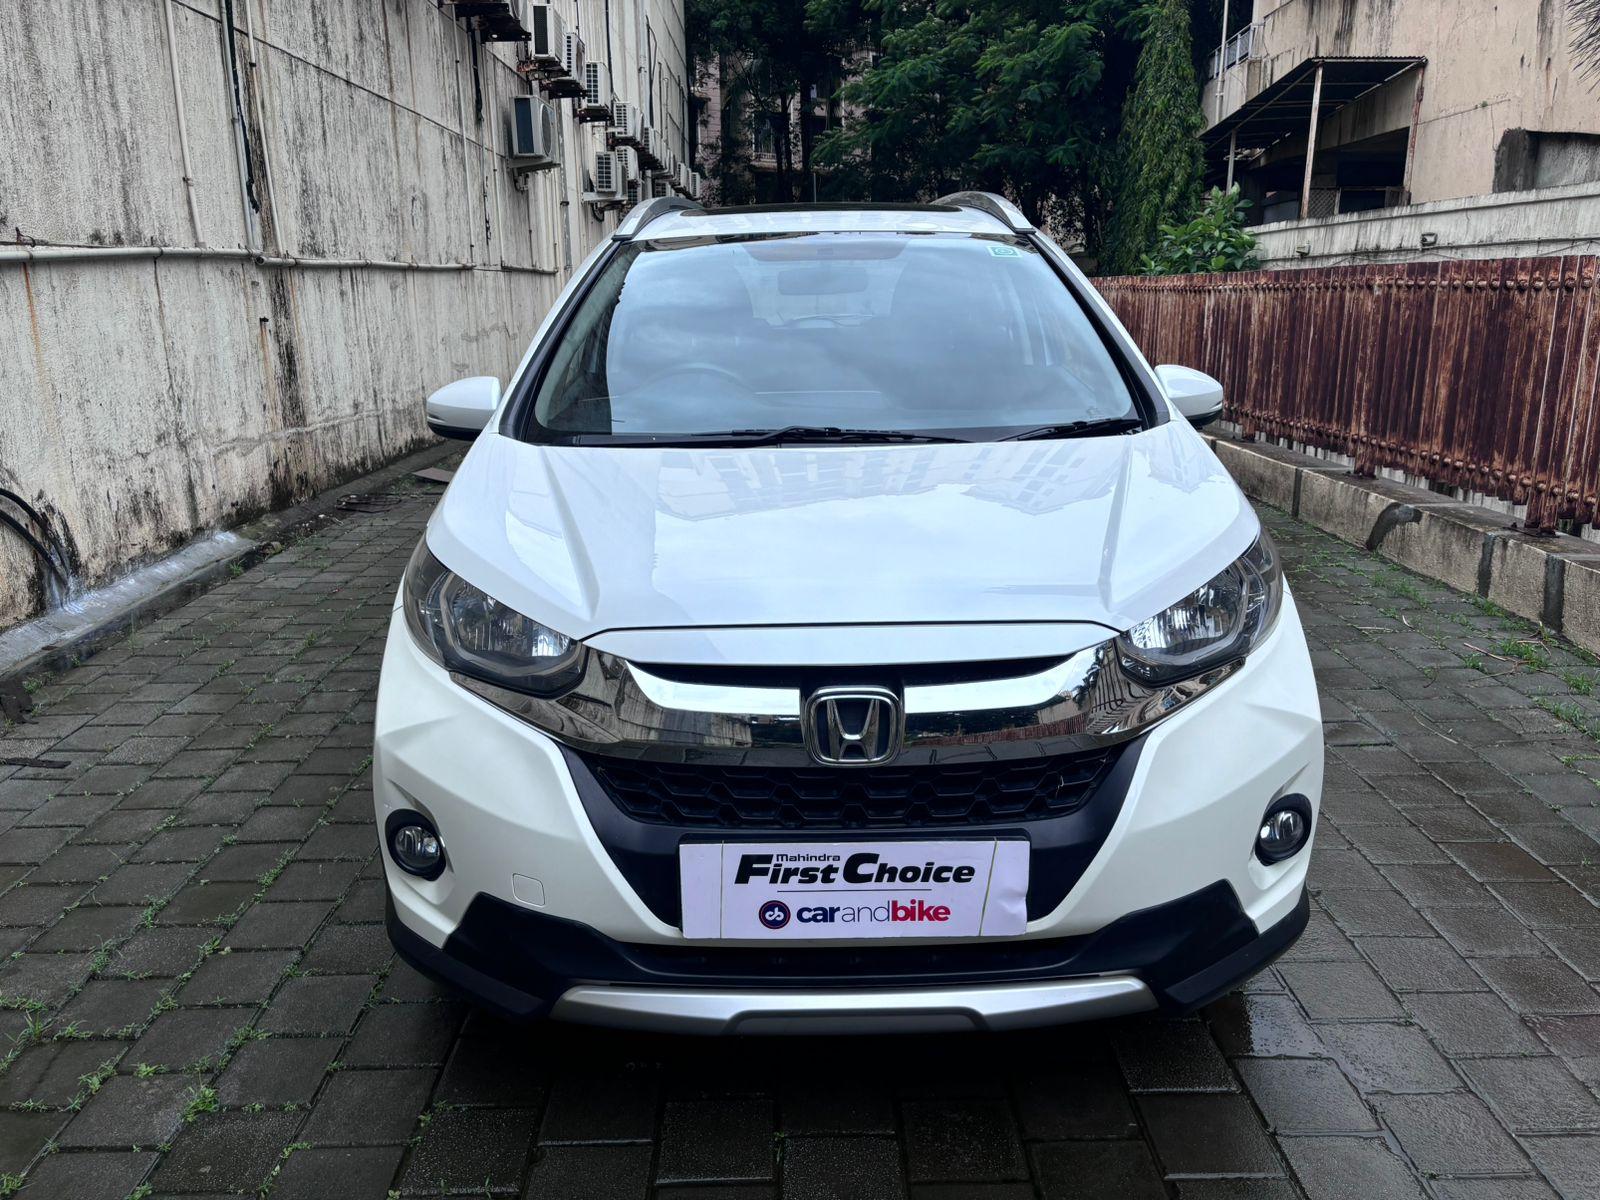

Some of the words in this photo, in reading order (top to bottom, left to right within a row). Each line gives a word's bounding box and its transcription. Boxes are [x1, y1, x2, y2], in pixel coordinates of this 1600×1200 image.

[734, 854, 840, 885] First
[842, 852, 976, 884] Choice
[776, 853, 841, 862] Mahindra
[796, 898, 951, 923] carandbike
